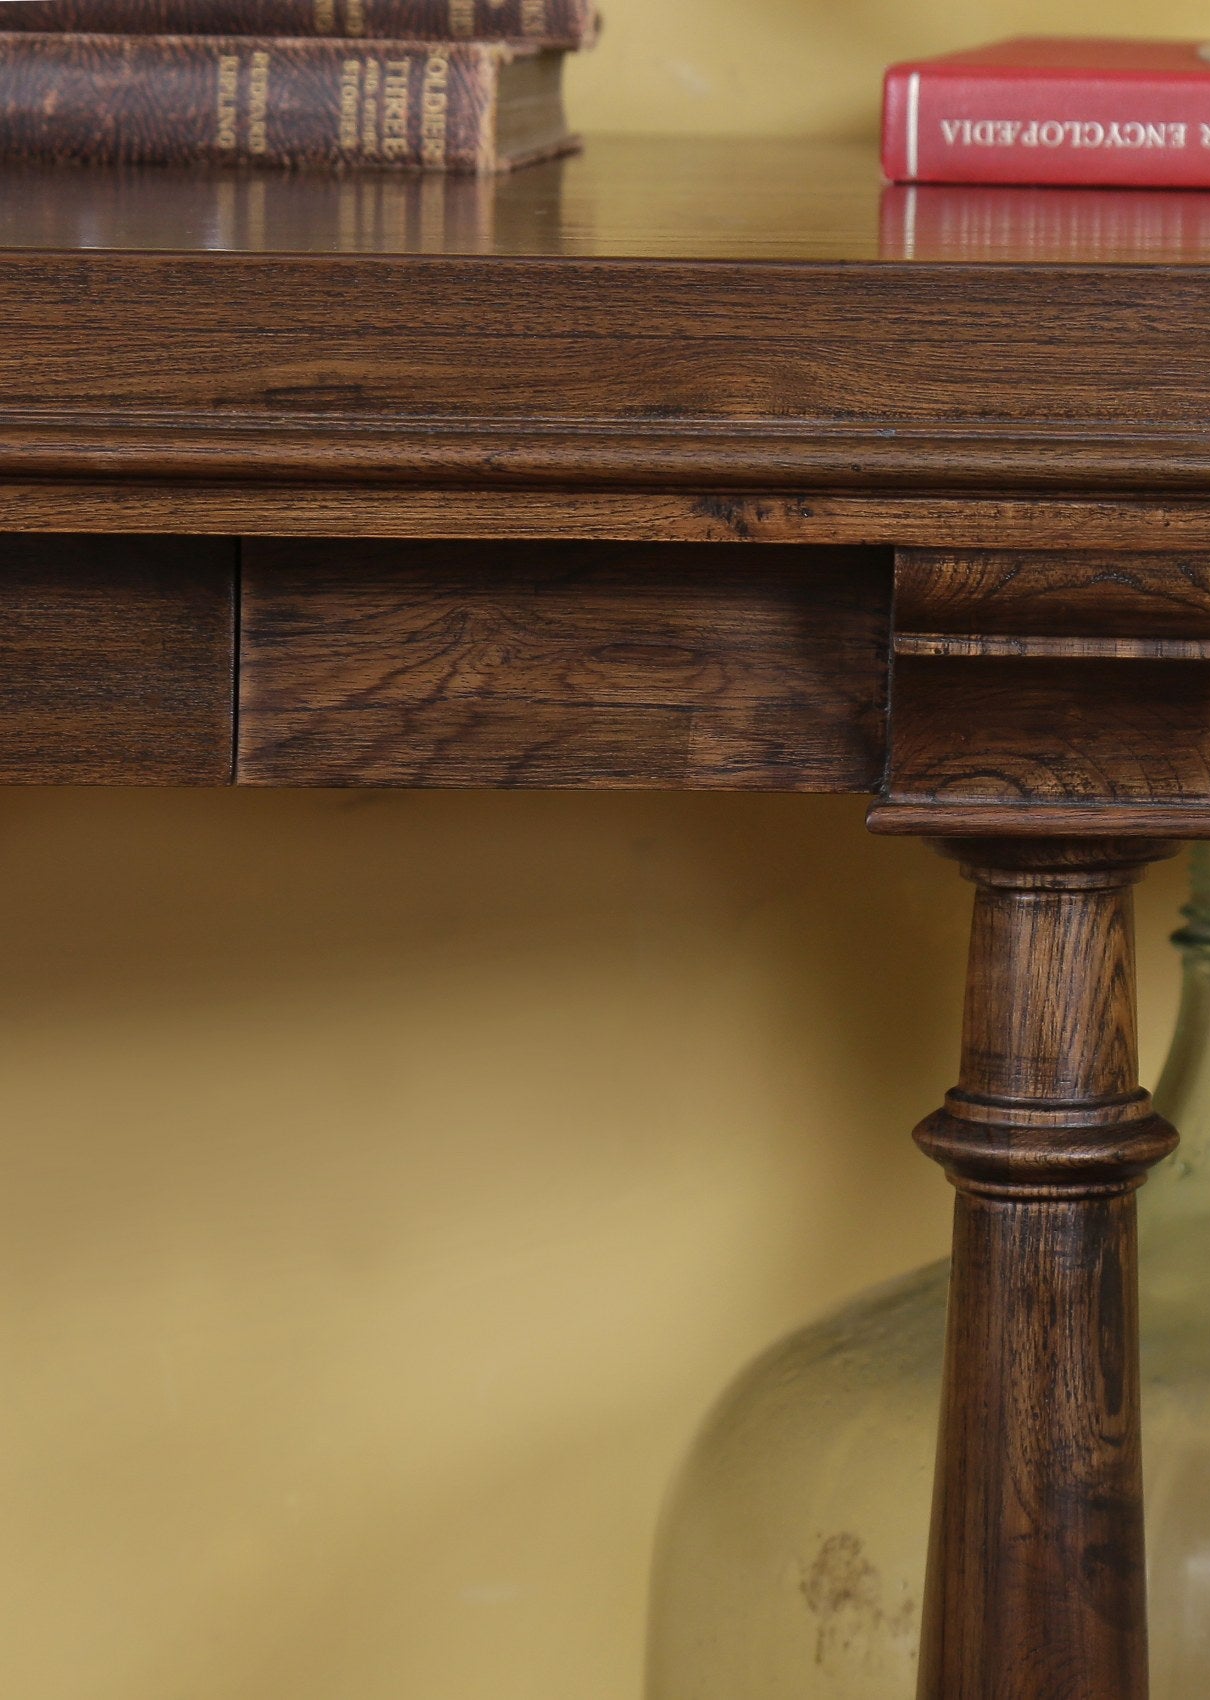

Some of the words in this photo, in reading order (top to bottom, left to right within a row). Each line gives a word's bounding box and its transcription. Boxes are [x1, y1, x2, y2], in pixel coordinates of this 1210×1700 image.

[216, 55, 240, 149] KIPLING
[339, 60, 361, 150] STORIES
[382, 57, 411, 159] THREE
[939, 119, 1188, 150] ENCYCLOPÆDIA
